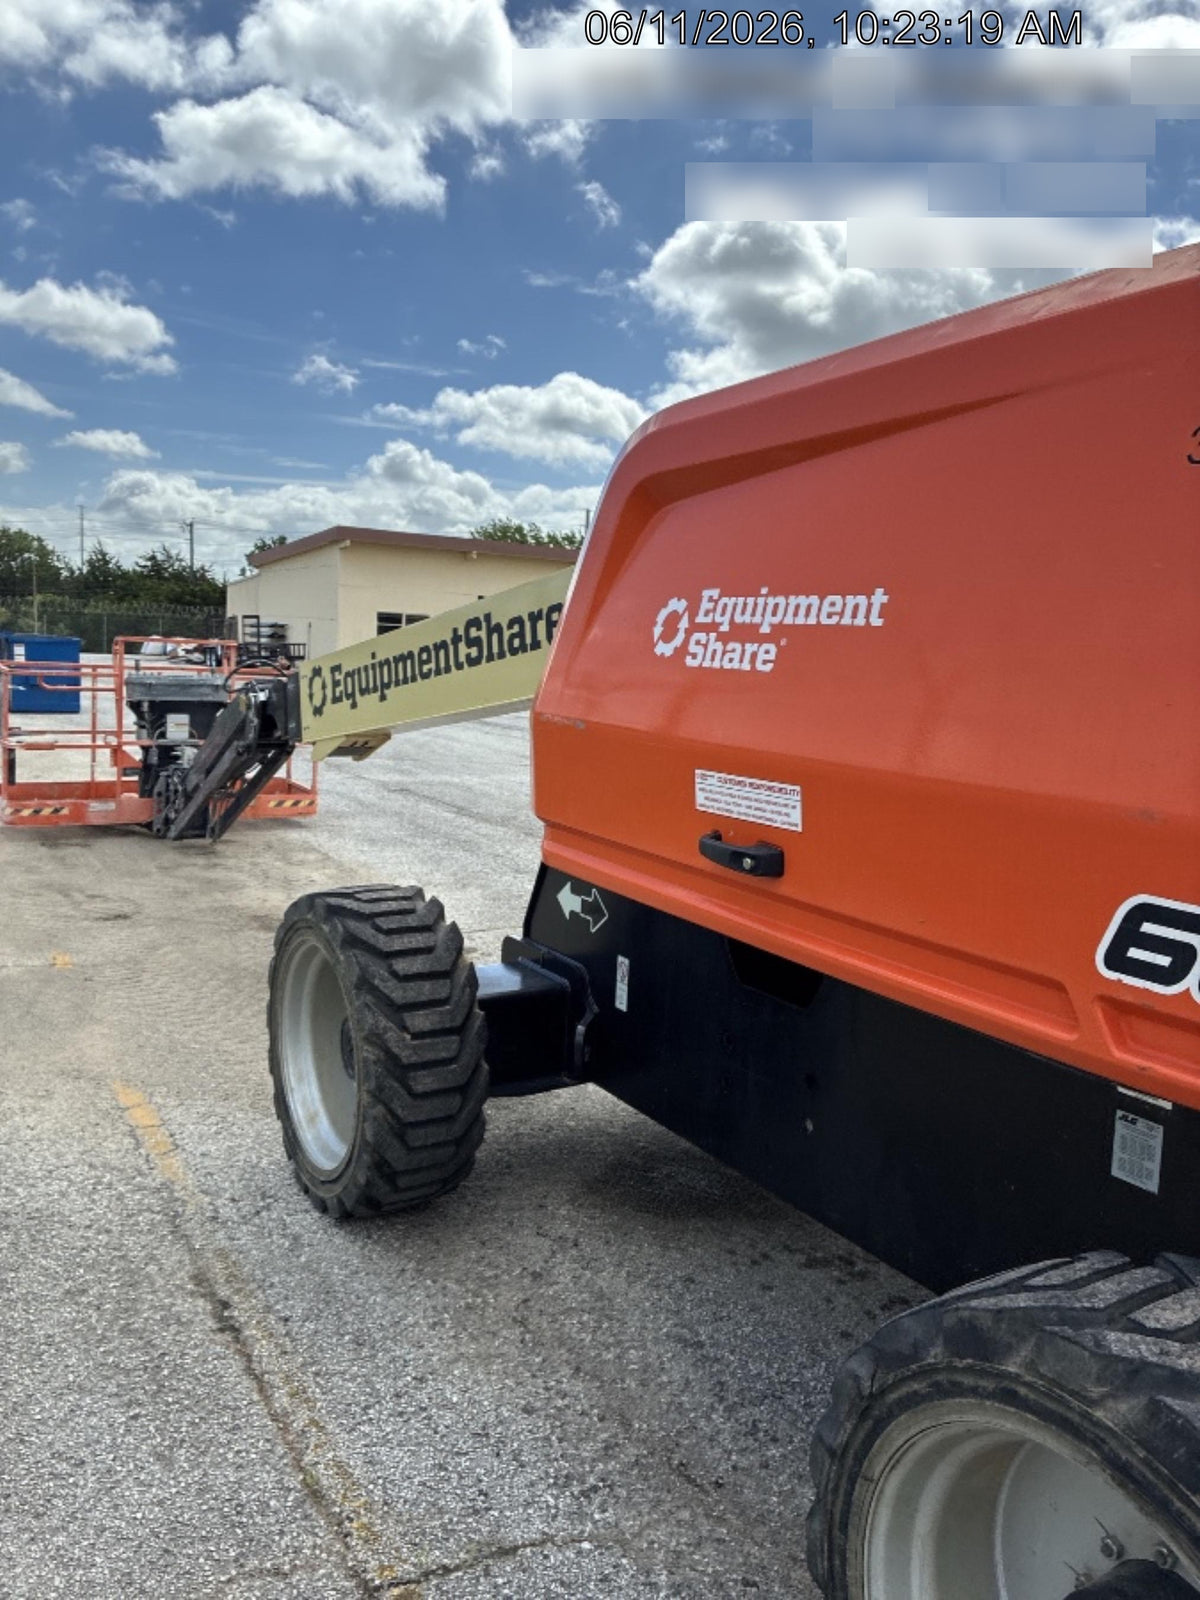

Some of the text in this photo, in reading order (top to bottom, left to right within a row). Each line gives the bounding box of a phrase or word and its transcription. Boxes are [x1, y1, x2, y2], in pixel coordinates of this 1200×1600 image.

[695, 586, 889, 633] Equipment
[329, 601, 564, 710] EquipmentShare
[685, 632, 777, 672] Share
[1095, 893, 1200, 1005] 6
